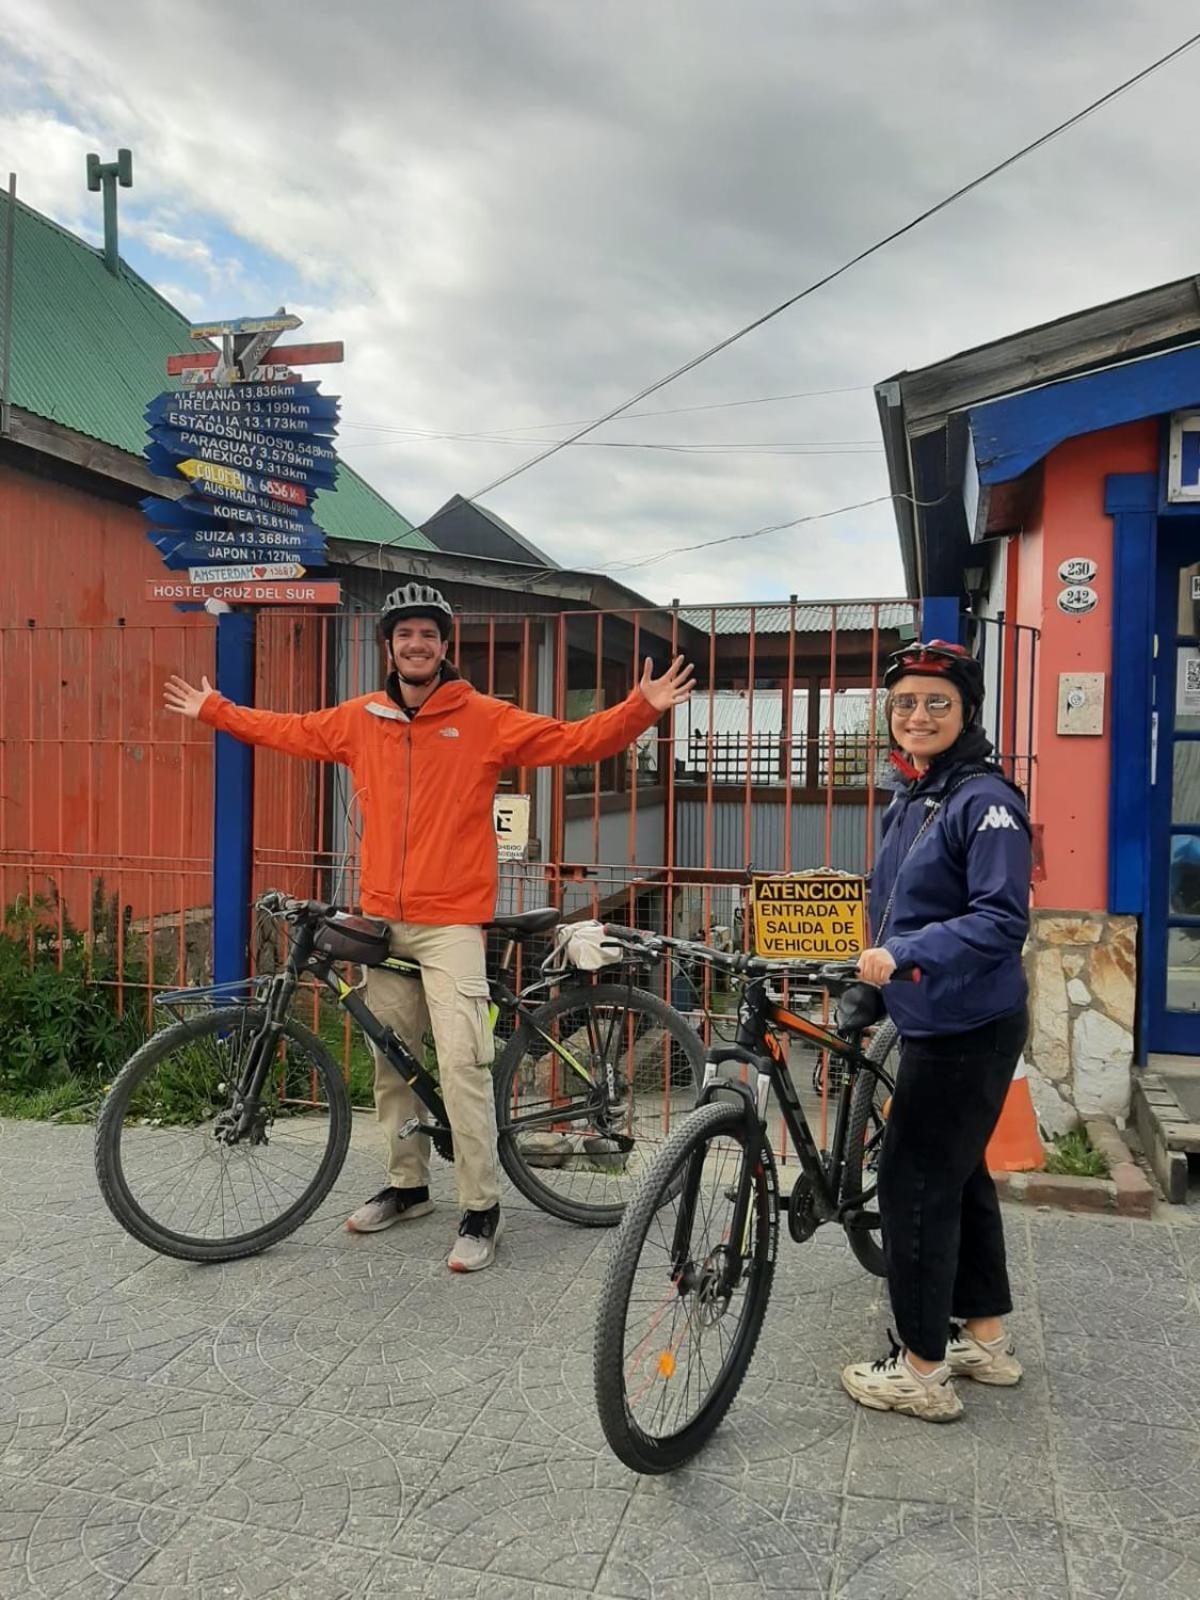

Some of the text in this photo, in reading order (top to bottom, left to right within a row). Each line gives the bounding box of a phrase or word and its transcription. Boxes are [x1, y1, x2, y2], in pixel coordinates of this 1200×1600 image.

[239, 385, 295, 398] 13.836km
[178, 399, 310, 414] IRELAND 13.199km
[243, 416, 308, 429] 13.173km
[180, 432, 314, 467] PARAGUAY 3.579km
[201, 447, 307, 480] MEXICO 9.313km
[203, 481, 257, 505] AUSTRALIA
[213, 505, 304, 532] KOREA 15.811km
[194, 530, 301, 545] SUIZA 13.368km
[207, 547, 301, 562] JAPON 17.127km
[193, 566, 254, 581] AMSTERDAM
[1067, 562, 1090, 576] 230
[154, 585, 316, 600] HOSTEL CRUZ DEL SUR
[1067, 590, 1089, 604] 242
[760, 882, 859, 899] ATENCION
[761, 903, 857, 917] ENTRADA Y
[766, 920, 855, 935] SALIDA DE
[763, 938, 860, 952] VEHICULOS
